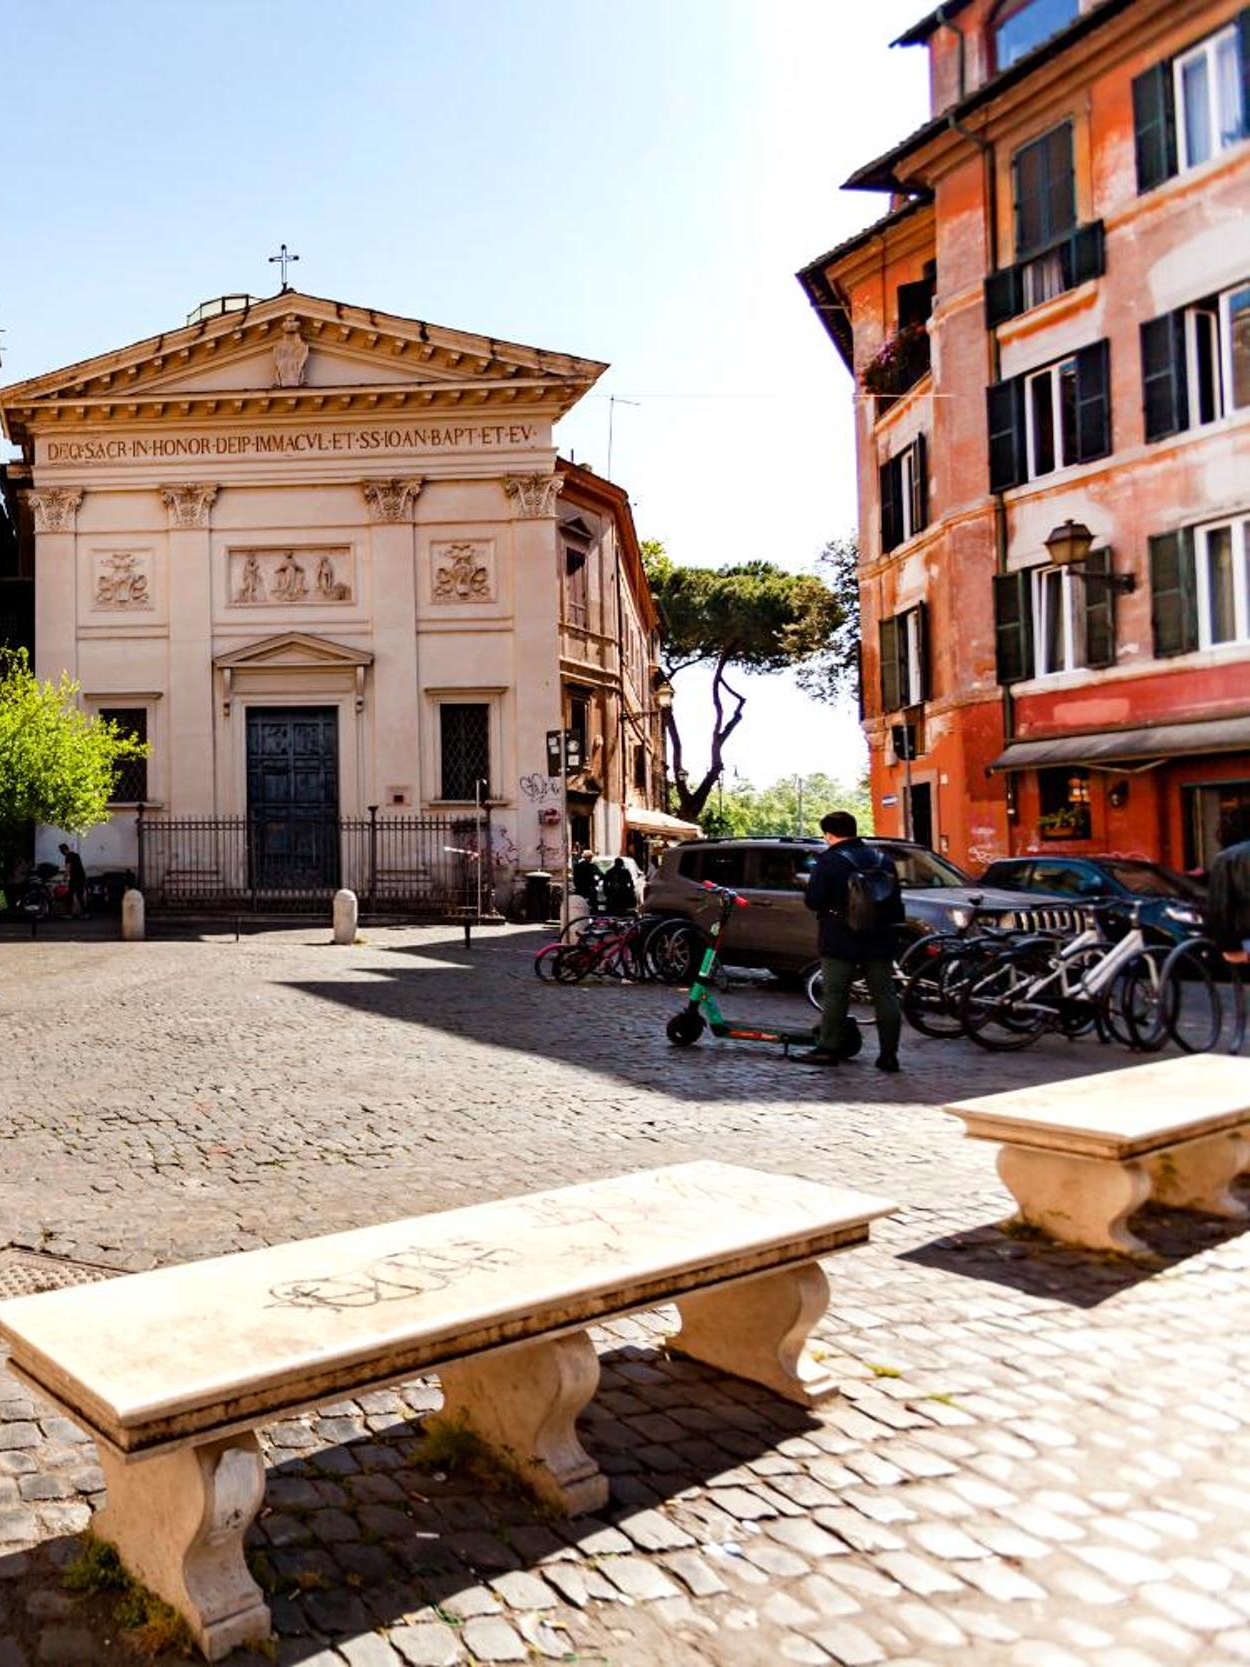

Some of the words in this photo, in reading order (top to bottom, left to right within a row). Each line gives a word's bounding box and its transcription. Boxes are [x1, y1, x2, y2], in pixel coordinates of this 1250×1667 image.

[83, 440, 127, 460] SACR
[131, 440, 148, 457] IN
[152, 438, 211, 458] HONOR
[215, 436, 251, 455] DEIP
[255, 432, 329, 453] IMMACVL
[332, 432, 354, 450] ET
[358, 431, 381, 449] SS
[384, 430, 427, 448] IOAN
[431, 427, 478, 446] BAPT
[481, 426, 505, 445] ET
